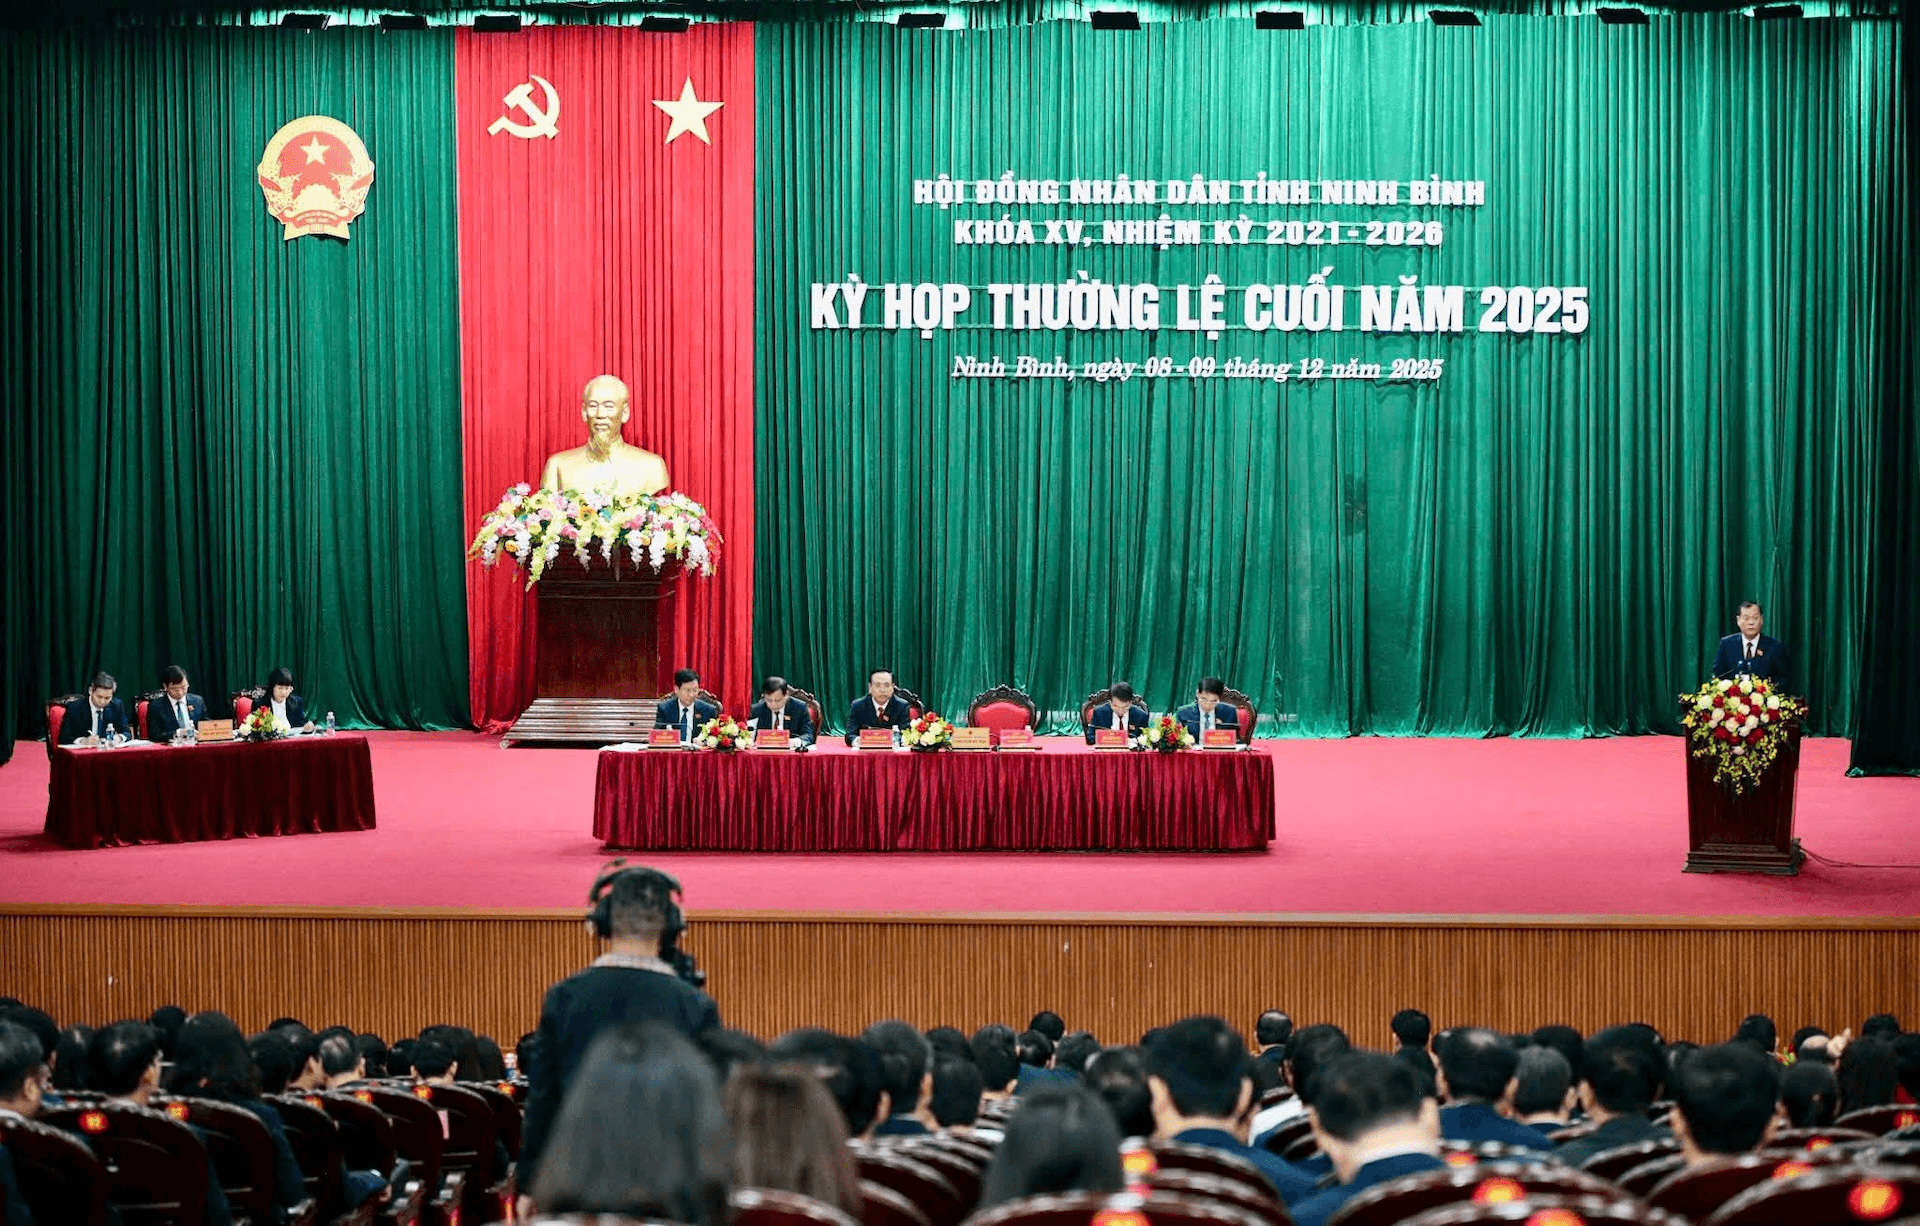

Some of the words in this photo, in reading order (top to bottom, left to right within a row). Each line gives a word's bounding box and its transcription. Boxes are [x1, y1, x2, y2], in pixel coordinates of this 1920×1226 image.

[914, 174, 964, 209] HỘI
[975, 170, 1060, 204] ĐỒNG
[1069, 174, 1156, 204] NHÂN
[1167, 174, 1231, 205] DÂN
[1239, 171, 1310, 205] TỈNH
[1321, 180, 1398, 205] NINH
[1409, 174, 1485, 206] BÌNH
[954, 214, 1035, 244] KHÓA
[1044, 220, 1092, 247] XV,
[1102, 214, 1200, 250] NHIỆM
[1214, 214, 1254, 244] KỲ
[811, 273, 868, 329] KỲ
[884, 283, 971, 339] HỌP
[987, 270, 1160, 331] THƯỜNG
[1176, 274, 1226, 340] LỆ
[1244, 266, 1343, 332] CUỐI
[1360, 275, 1464, 333] NĂM
[1479, 286, 1590, 333] 2025
[951, 356, 1006, 378] Ninh
[1015, 356, 1076, 381] Bình,
[1082, 357, 1137, 382] ngày
[1223, 356, 1293, 383] tháng
[1297, 358, 1325, 379] 12
[1330, 357, 1381, 379] năm
[1388, 358, 1445, 380] 2025
